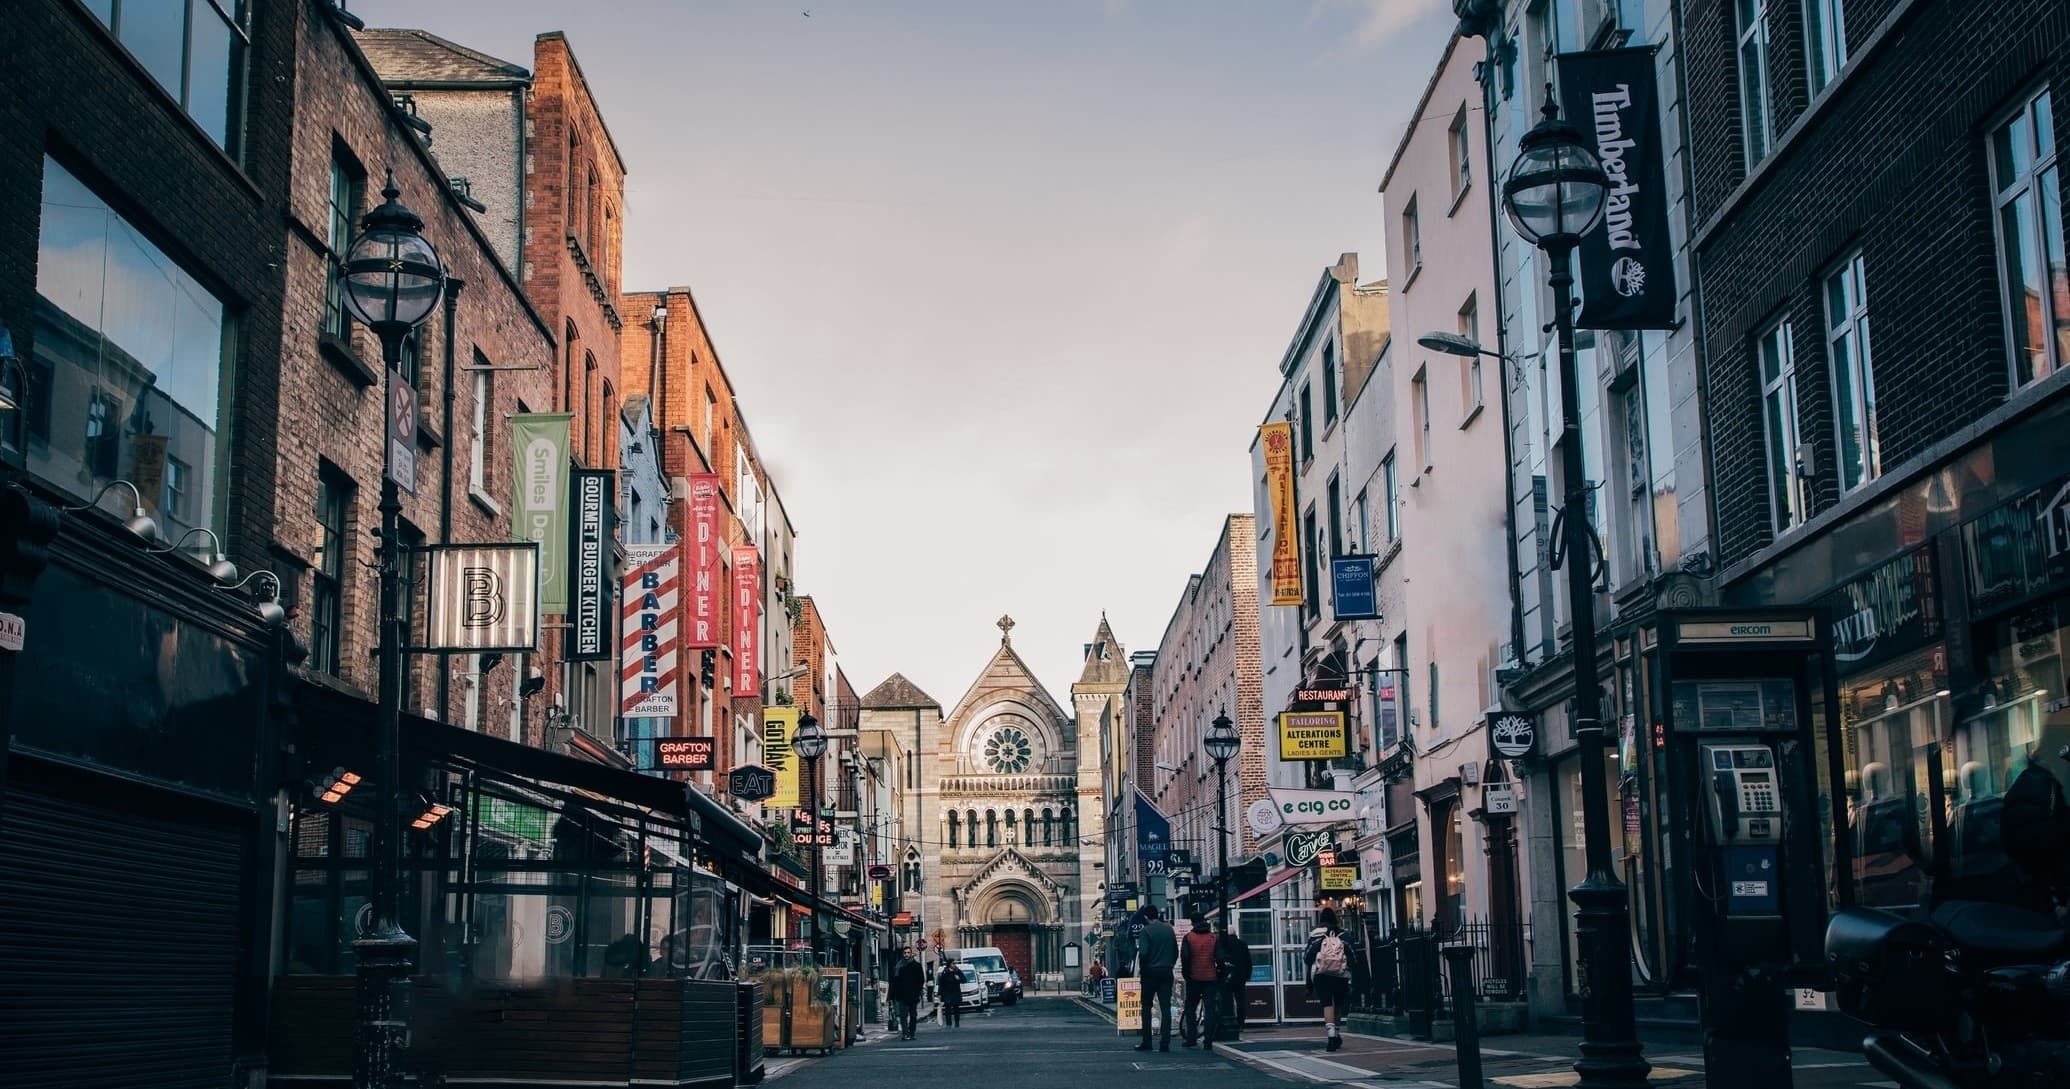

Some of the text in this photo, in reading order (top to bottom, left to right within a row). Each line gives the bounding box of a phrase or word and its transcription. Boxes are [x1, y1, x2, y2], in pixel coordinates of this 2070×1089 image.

[1591, 83, 1642, 250] Timberland
[534, 448, 549, 505] Smiles
[636, 550, 675, 558] GRAFTON
[582, 476, 599, 654] GOURMET BURGER KITCHEN
[1336, 571, 1369, 579] CHIFFON
[697, 522, 710, 642] DINER
[463, 567, 506, 628] B
[641, 572, 661, 694] BARBER
[740, 588, 752, 691] DINER
[634, 695, 673, 703] GRAFTON
[1298, 690, 1347, 700] RESTAURANT
[635, 705, 670, 713] BARBER
[1290, 718, 1335, 726] TAILORING
[1287, 729, 1341, 739] ALTERATIONS
[660, 743, 711, 752] GRAFTON
[1298, 740, 1329, 749] CENTRE
[663, 754, 708, 764] BARBER
[731, 772, 772, 795] EAT
[1283, 799, 1351, 815] e cig co
[1148, 860, 1166, 875] 22
